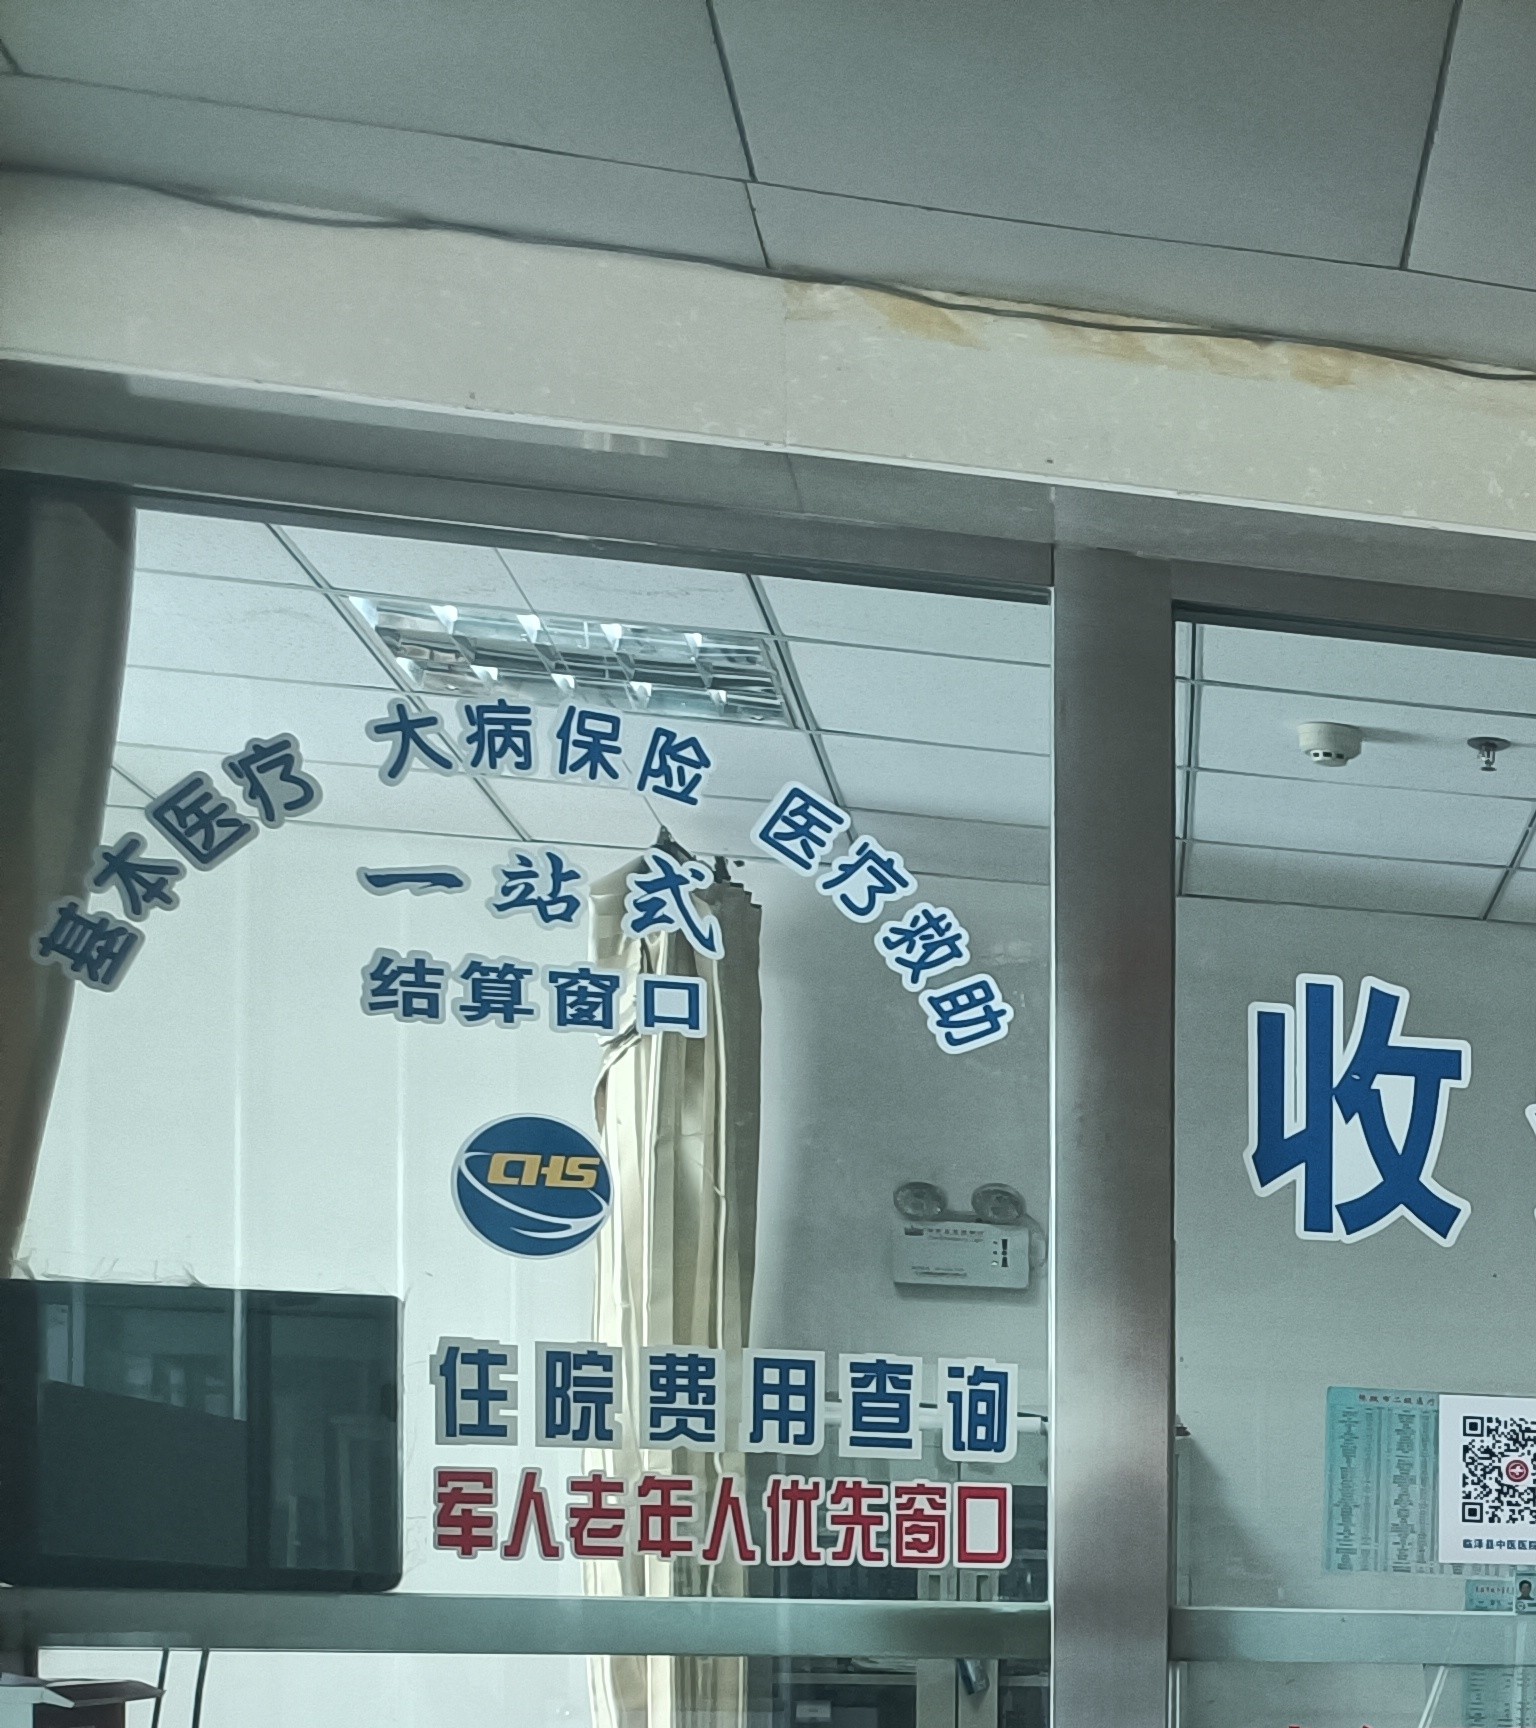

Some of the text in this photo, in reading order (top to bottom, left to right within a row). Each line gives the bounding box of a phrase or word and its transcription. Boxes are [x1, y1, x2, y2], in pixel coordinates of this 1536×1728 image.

[34, 702, 1006, 1048] 基本医疗 大病保险 医疗救助
[361, 852, 720, 958] 一站式
[366, 955, 708, 1032] 结算窗口
[486, 1152, 601, 1189] CHS
[437, 1343, 1010, 1454] 住院费用查询
[435, 1469, 1011, 1566] 军人老年人优先窗口
